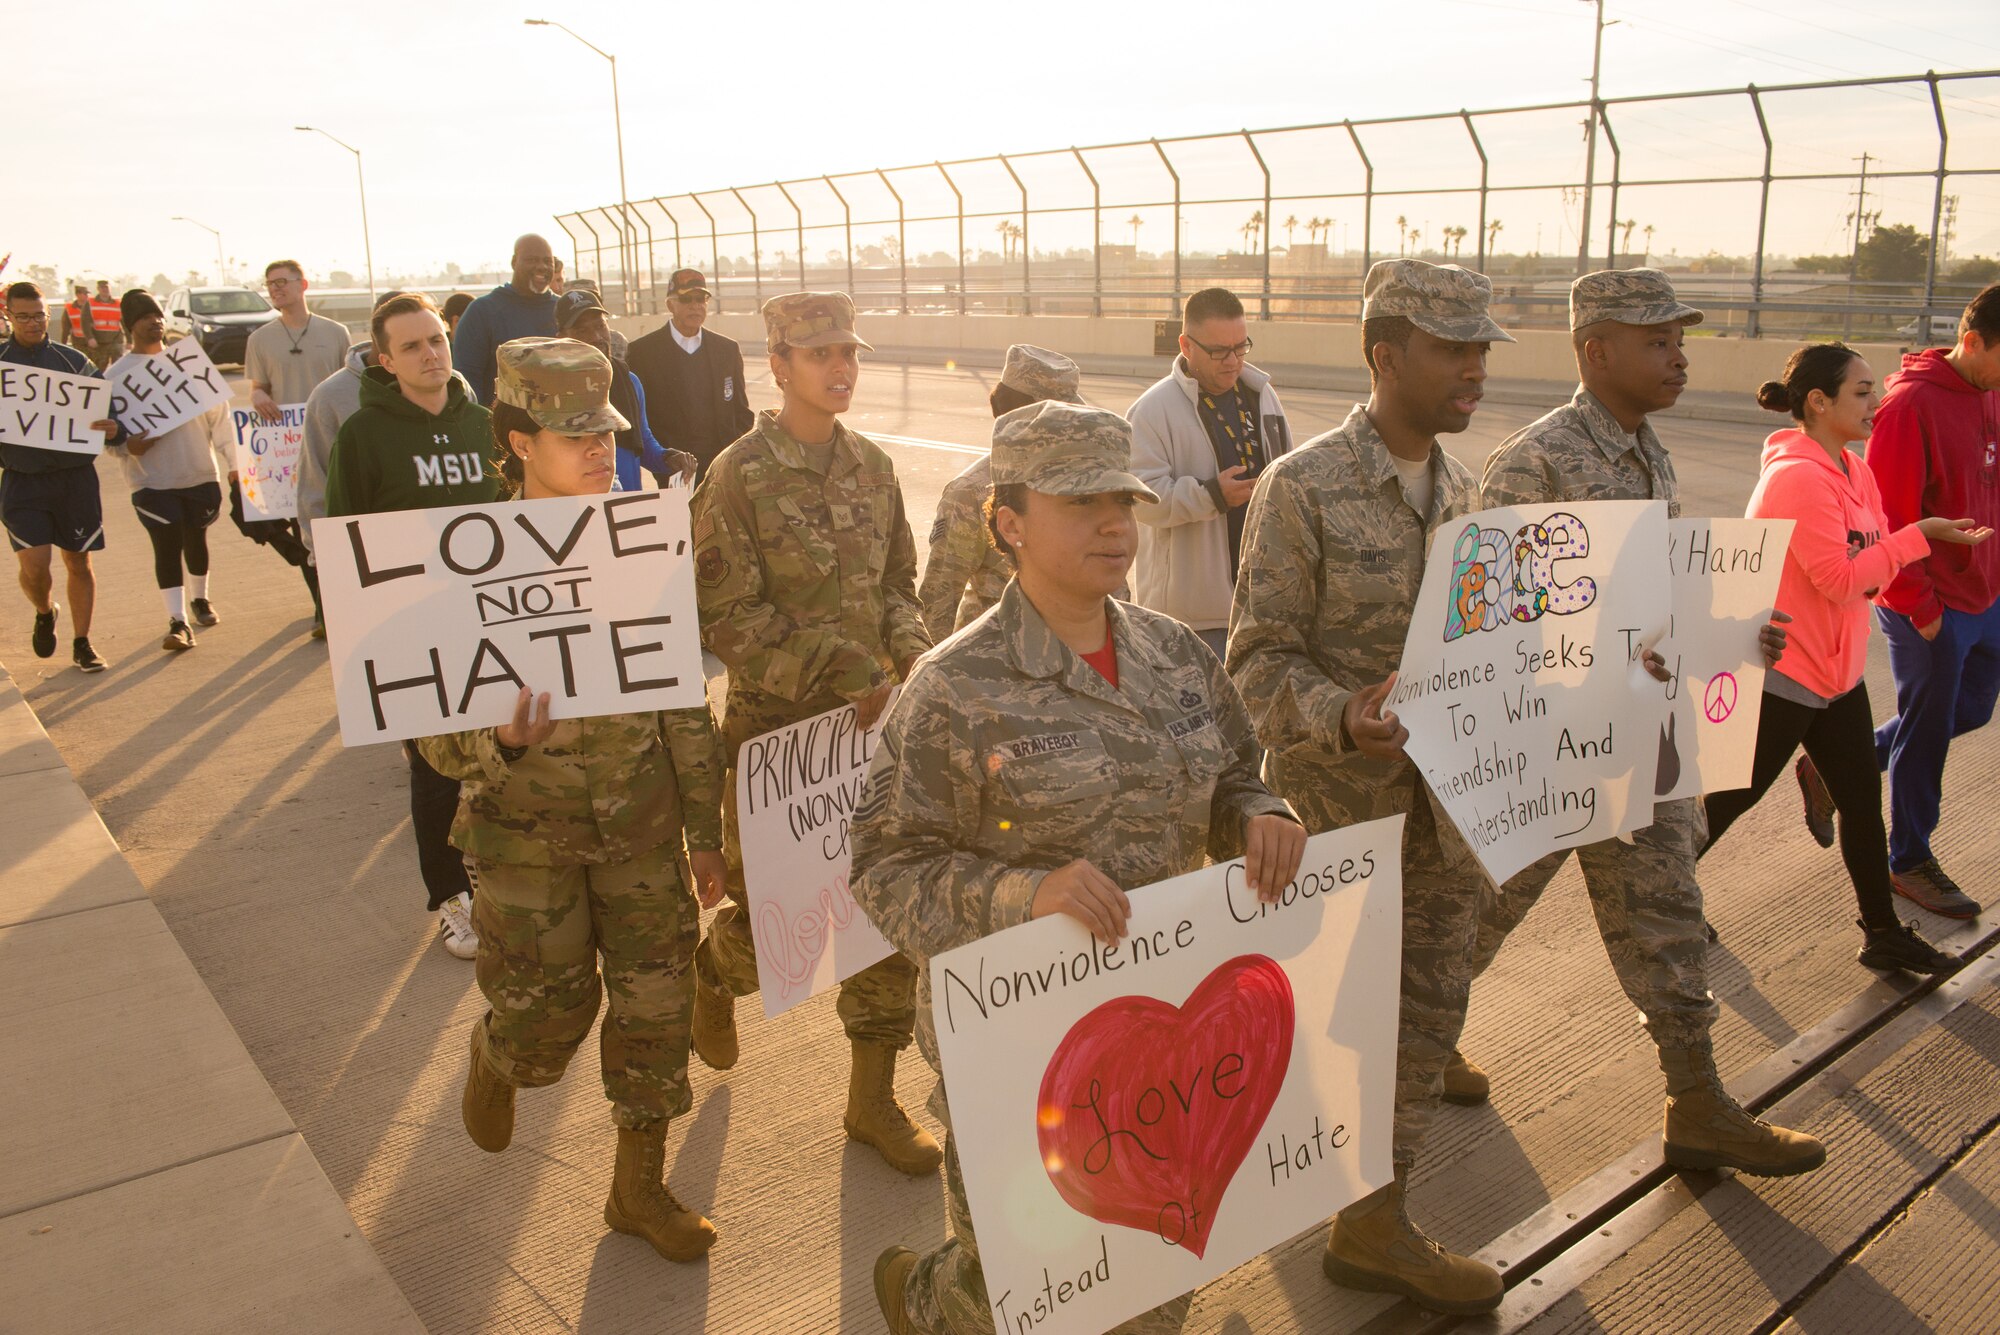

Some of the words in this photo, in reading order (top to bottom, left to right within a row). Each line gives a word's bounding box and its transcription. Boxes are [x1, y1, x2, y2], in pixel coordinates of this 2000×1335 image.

[0, 369, 100, 410] ESIST
[0, 410, 89, 444] VIL
[413, 452, 483, 487] MSU
[346, 493, 687, 588] LOVE,
[1443, 512, 1597, 642] Peace
[1688, 528, 1767, 575] Hand
[476, 577, 592, 622] NOT
[364, 615, 679, 730] HATE
[1388, 658, 1496, 706] Nonviolence
[1515, 634, 1595, 675] Seeks
[1618, 629, 1643, 668] To
[1012, 733, 1079, 758] BRAVEBOY
[1447, 703, 1476, 743] To
[1503, 685, 1546, 725] Win
[747, 707, 875, 815] PRINCIPLE
[1429, 741, 1527, 803] Friendship
[1556, 722, 1614, 762] And
[1460, 777, 1596, 853] Understanding
[944, 918, 1195, 1034] Nonviolence
[1225, 849, 1375, 923] Cooses
[1072, 1052, 1246, 1174] Love
[996, 1234, 1110, 1335] Instead
[1157, 1190, 1202, 1245] Of
[1267, 1116, 1351, 1187] Hate
